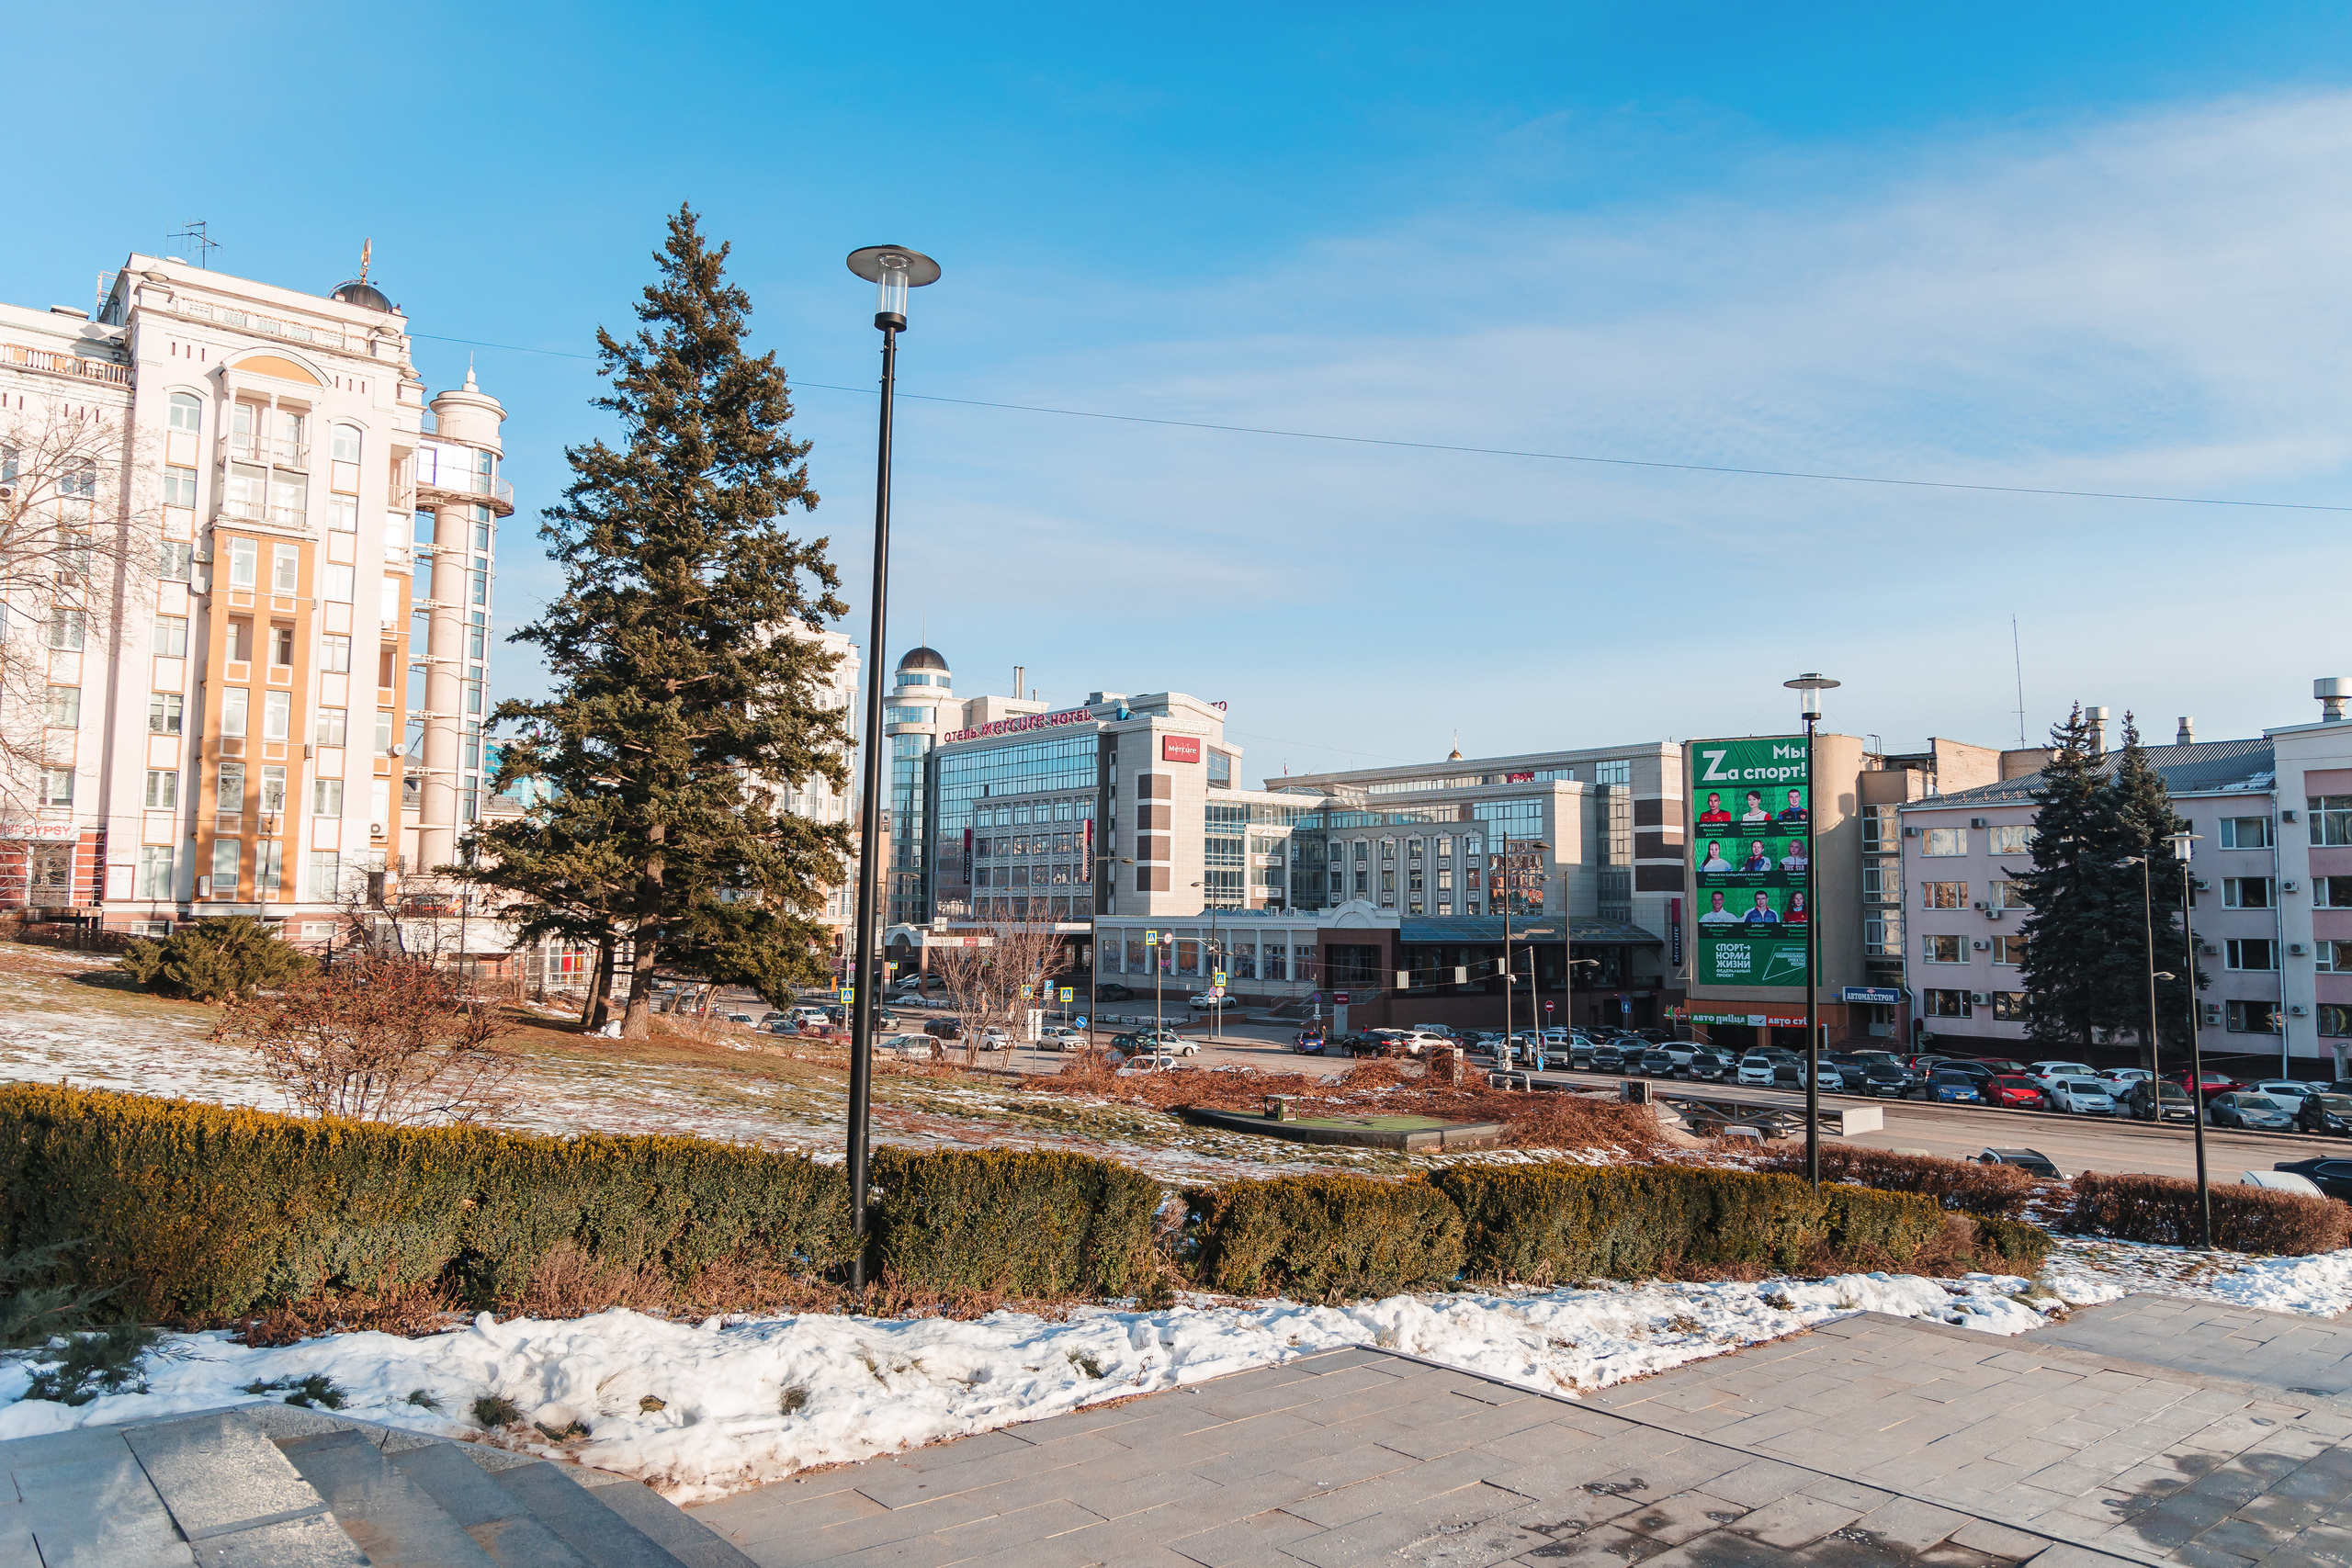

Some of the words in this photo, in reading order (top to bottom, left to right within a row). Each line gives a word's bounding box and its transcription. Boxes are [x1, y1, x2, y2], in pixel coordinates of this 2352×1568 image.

[944, 727, 978, 743] ОТЕЛЬ
[1050, 709, 1092, 727] HOTEL
[1168, 745, 1197, 754] Mercure
[1773, 743, 1806, 760] Мы
[1743, 761, 1806, 782] спорт!
[24, 825, 71, 835] GYPSY
[1715, 952, 1750, 960] НОРМА
[1716, 960, 1750, 968] ЖИЗНИ
[1846, 992, 1894, 1002] АВТОМАТСТРОМ
[1768, 1018, 1791, 1027] АВТО
